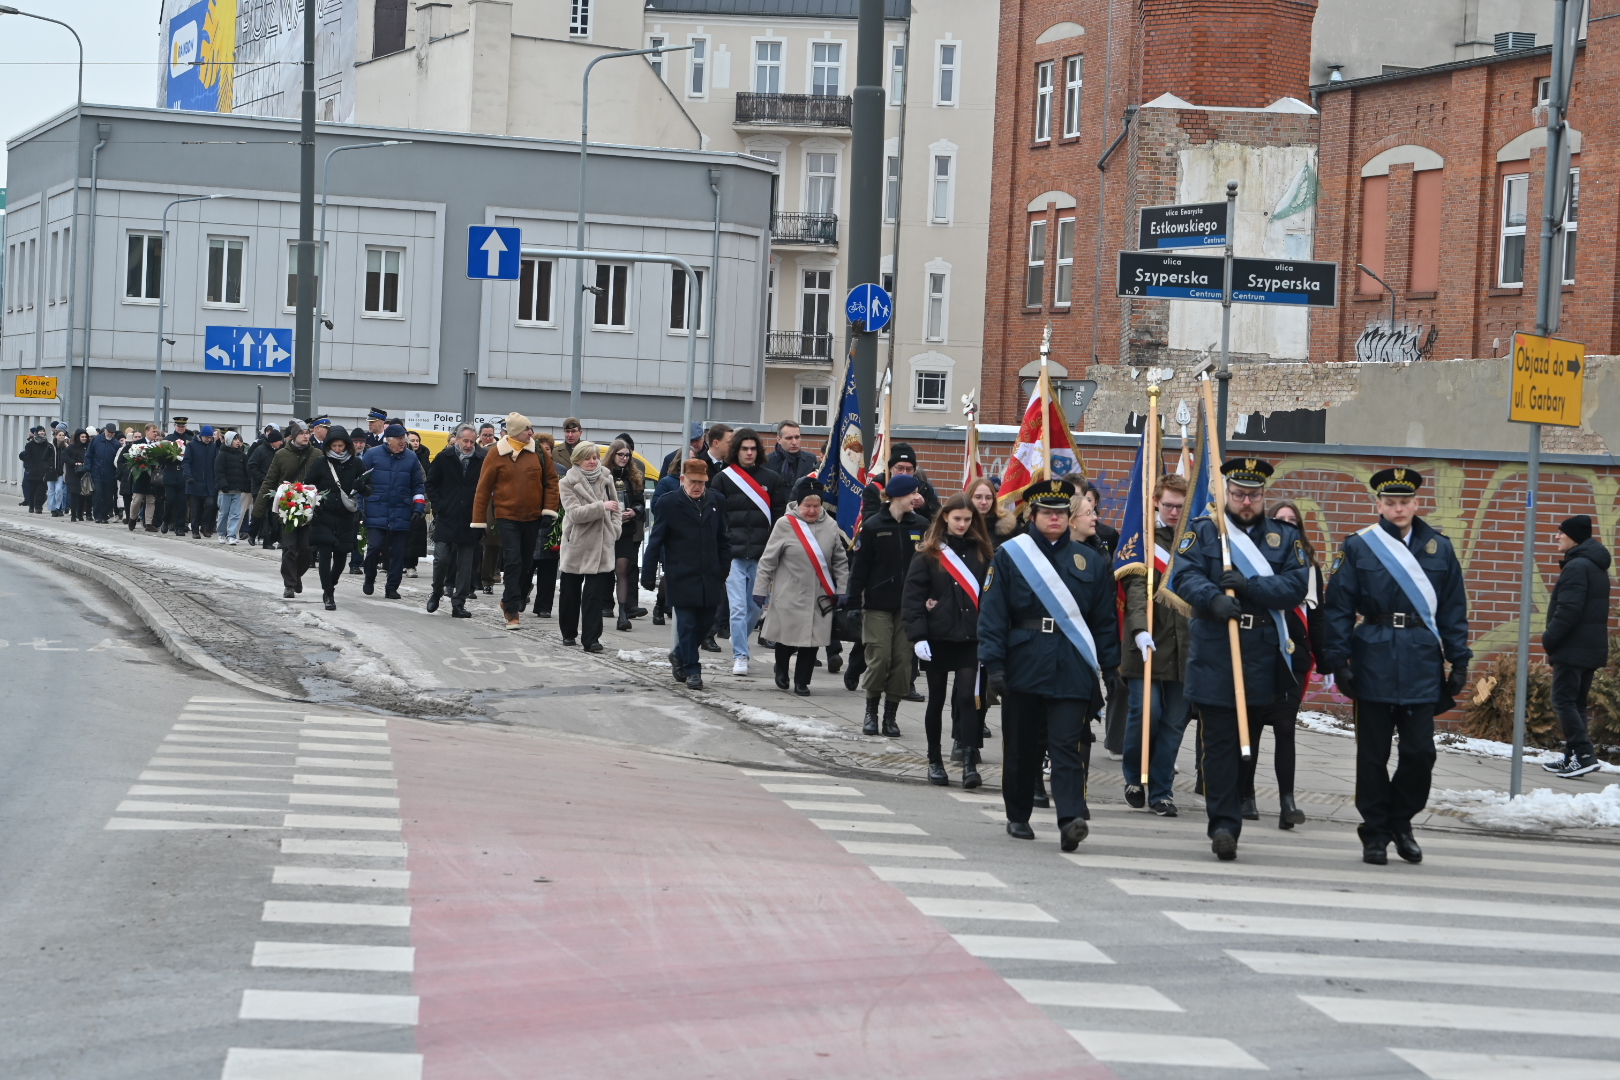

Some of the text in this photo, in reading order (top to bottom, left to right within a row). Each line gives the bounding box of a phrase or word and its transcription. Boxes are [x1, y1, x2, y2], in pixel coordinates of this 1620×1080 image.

[1165, 207, 1204, 217] ulica Ewarysta
[1150, 219, 1218, 235] Estkowskiego
[1203, 236, 1226, 245] Centrum
[1163, 258, 1182, 266] ulica
[1275, 264, 1294, 272] ulica
[1135, 268, 1209, 286] Szyperska
[1247, 274, 1321, 292] Szyperska
[1189, 289, 1222, 299] Centrum
[1232, 291, 1265, 301] Centrum
[1516, 346, 1564, 379] Objazd do
[22, 378, 50, 387] Koniec
[19, 387, 52, 396] objazdu
[1515, 384, 1566, 420] ul. Garbary
[434, 413, 454, 423] Pole
[456, 414, 485, 424] Dce
